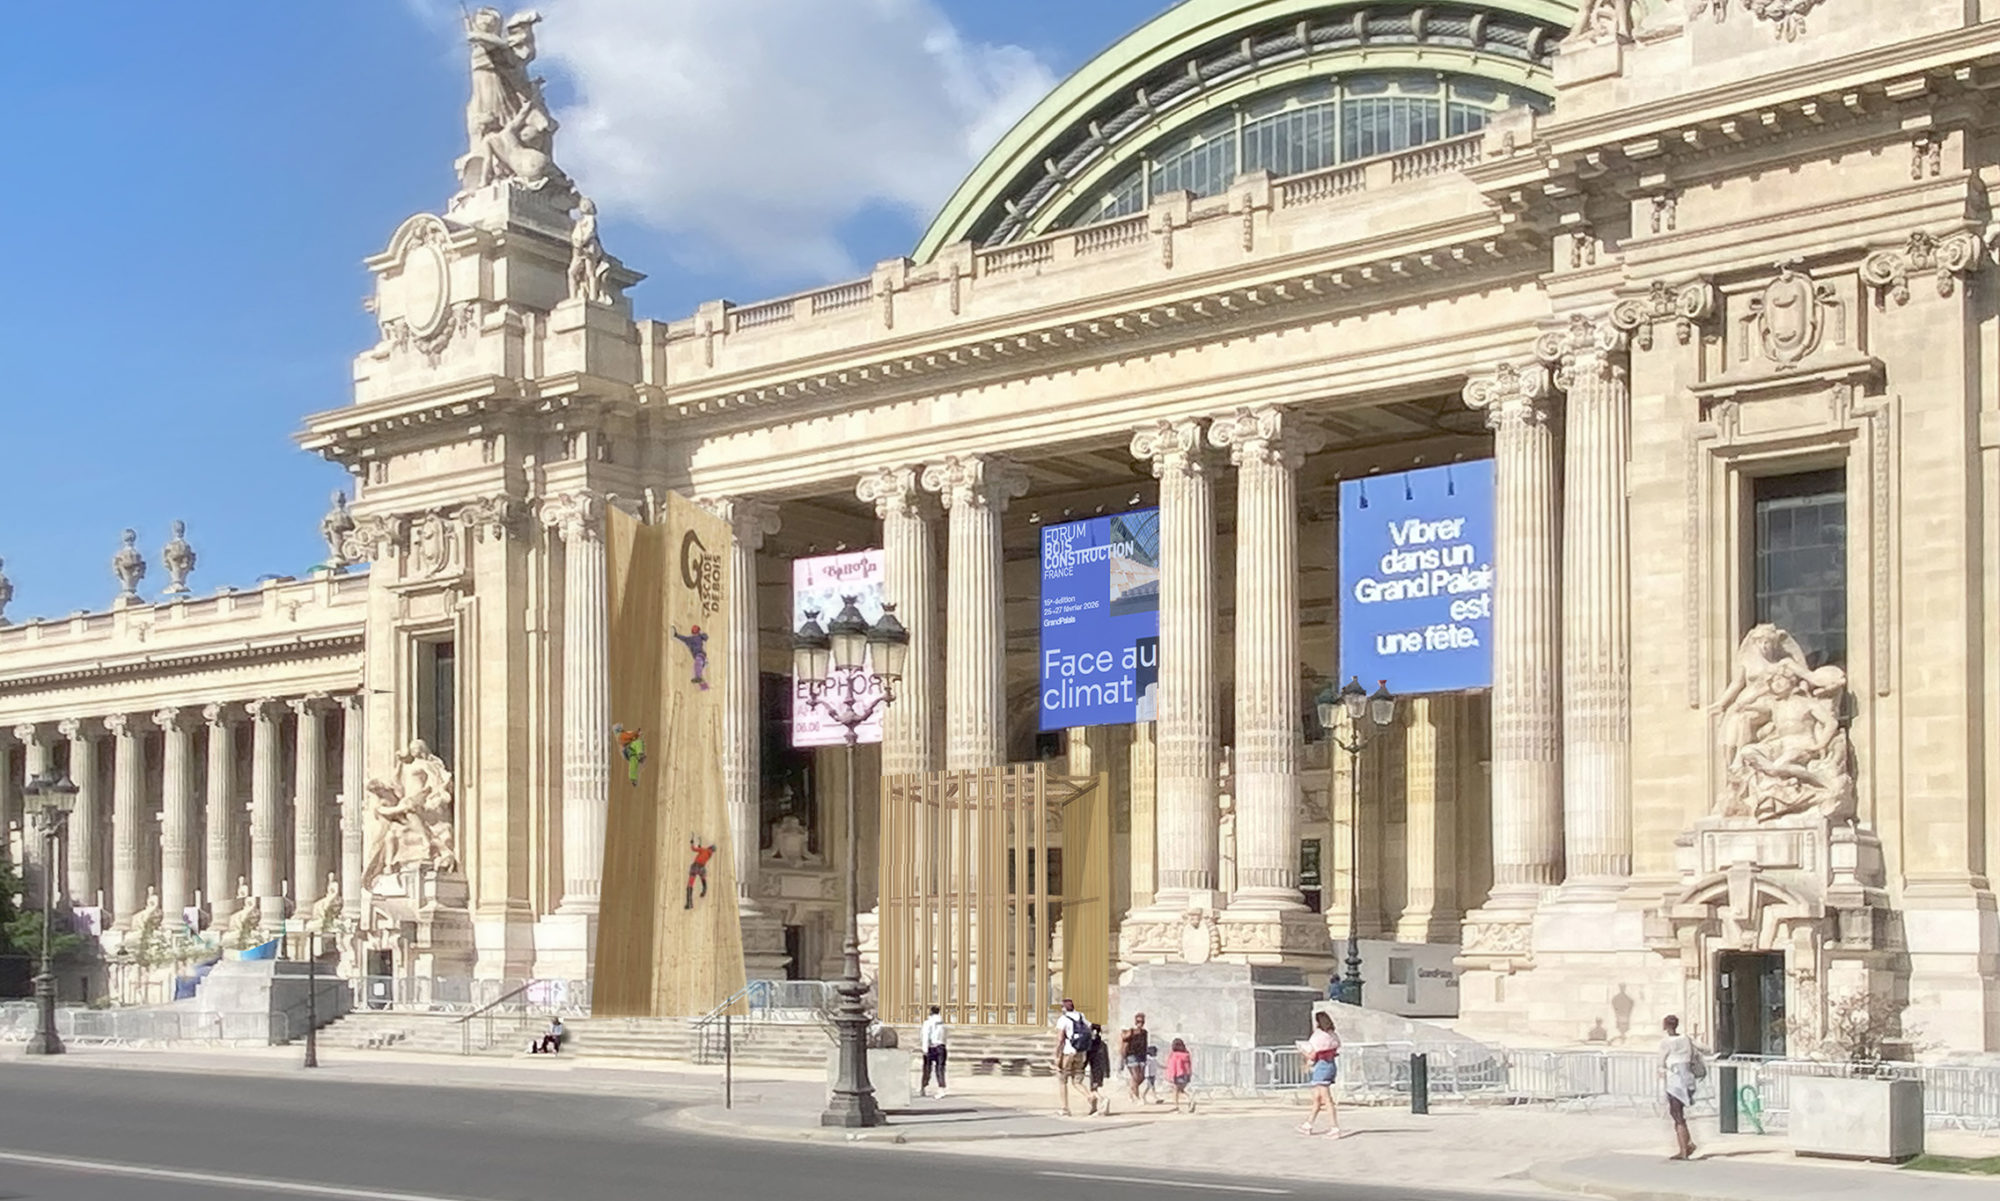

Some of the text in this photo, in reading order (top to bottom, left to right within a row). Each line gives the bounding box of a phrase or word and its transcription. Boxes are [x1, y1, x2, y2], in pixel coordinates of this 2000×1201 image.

[1045, 524, 1086, 542] FORUM
[1388, 516, 1466, 546] Vibrer
[1044, 540, 1073, 557] BOIS
[1044, 541, 1134, 569] CONSTRUCTION
[1381, 543, 1475, 574] dans un
[1044, 567, 1074, 580] FRANCE
[1083, 601, 1099, 610] 2026
[1450, 592, 1491, 622] est
[1376, 632, 1423, 655] une
[1045, 644, 1157, 679] Face au
[1043, 674, 1134, 711] climat
